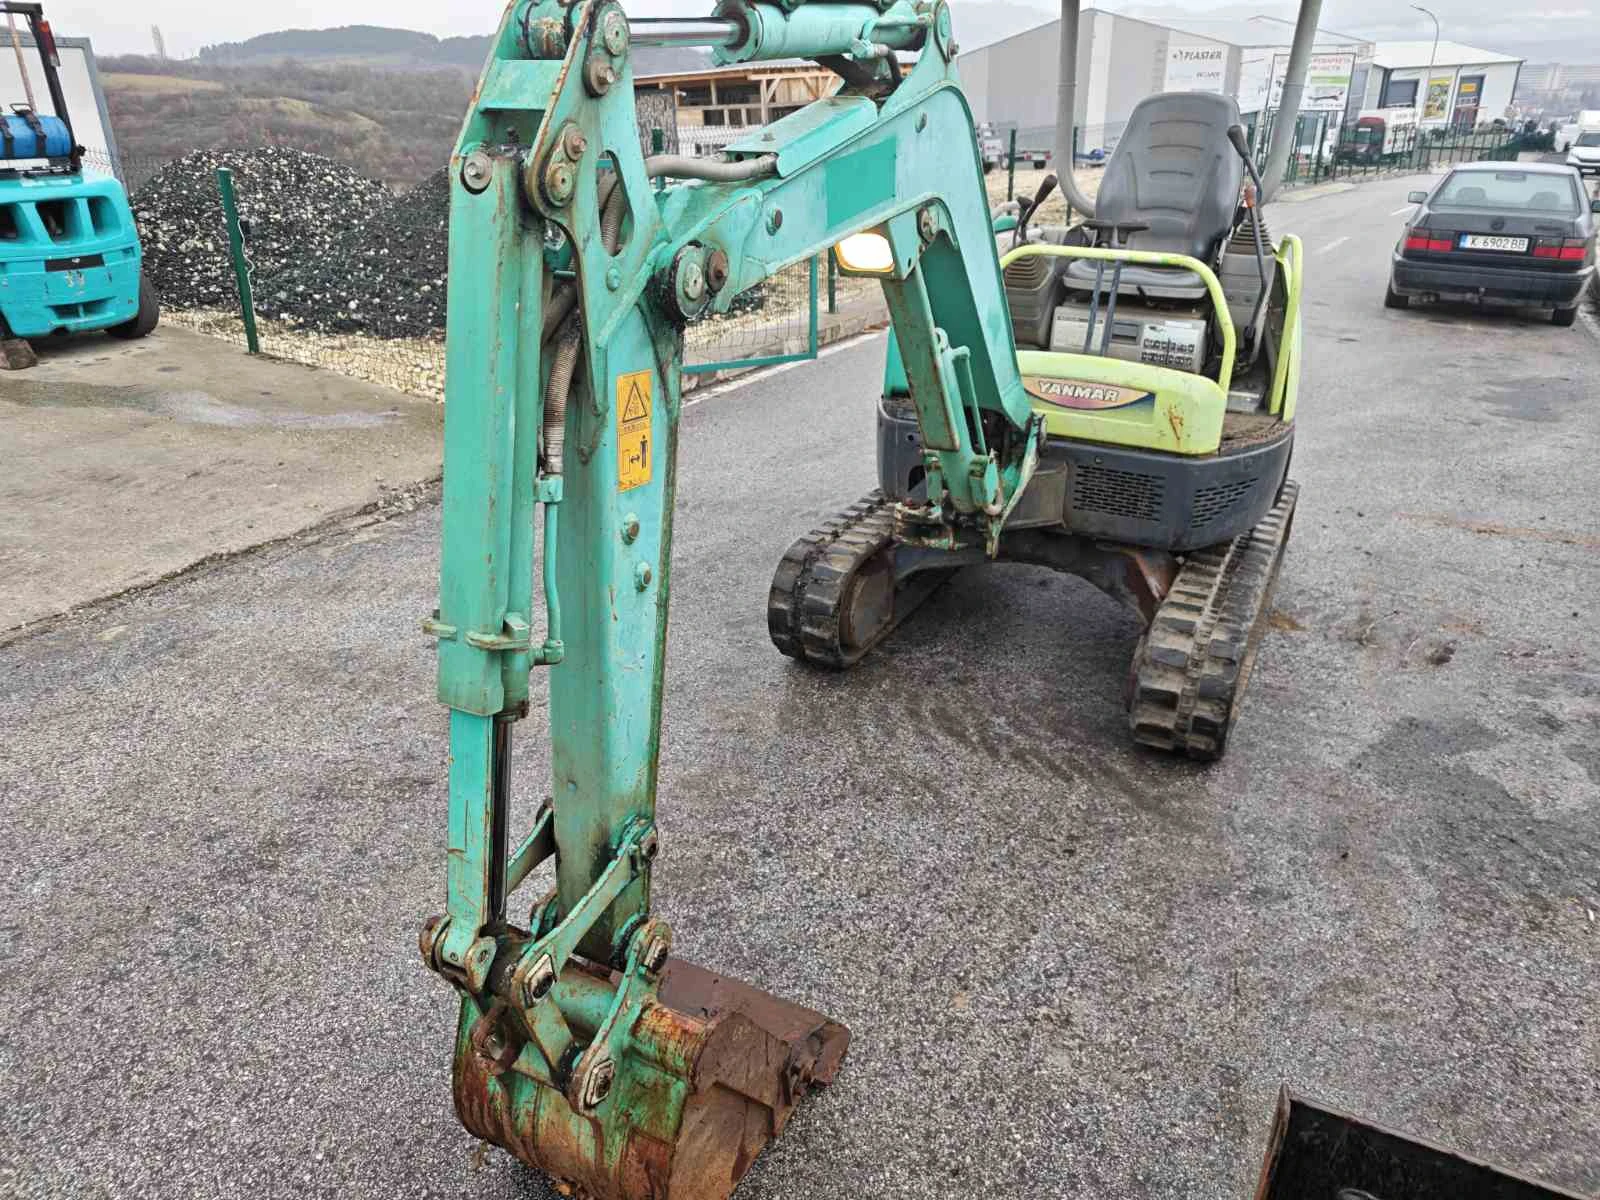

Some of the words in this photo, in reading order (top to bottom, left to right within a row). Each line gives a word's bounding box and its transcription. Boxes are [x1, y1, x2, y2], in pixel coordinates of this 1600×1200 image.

[1470, 235, 1479, 247] K
[1483, 237, 1509, 249] 6902
[1510, 238, 1526, 250] BB
[1039, 381, 1120, 401] YANMAR
